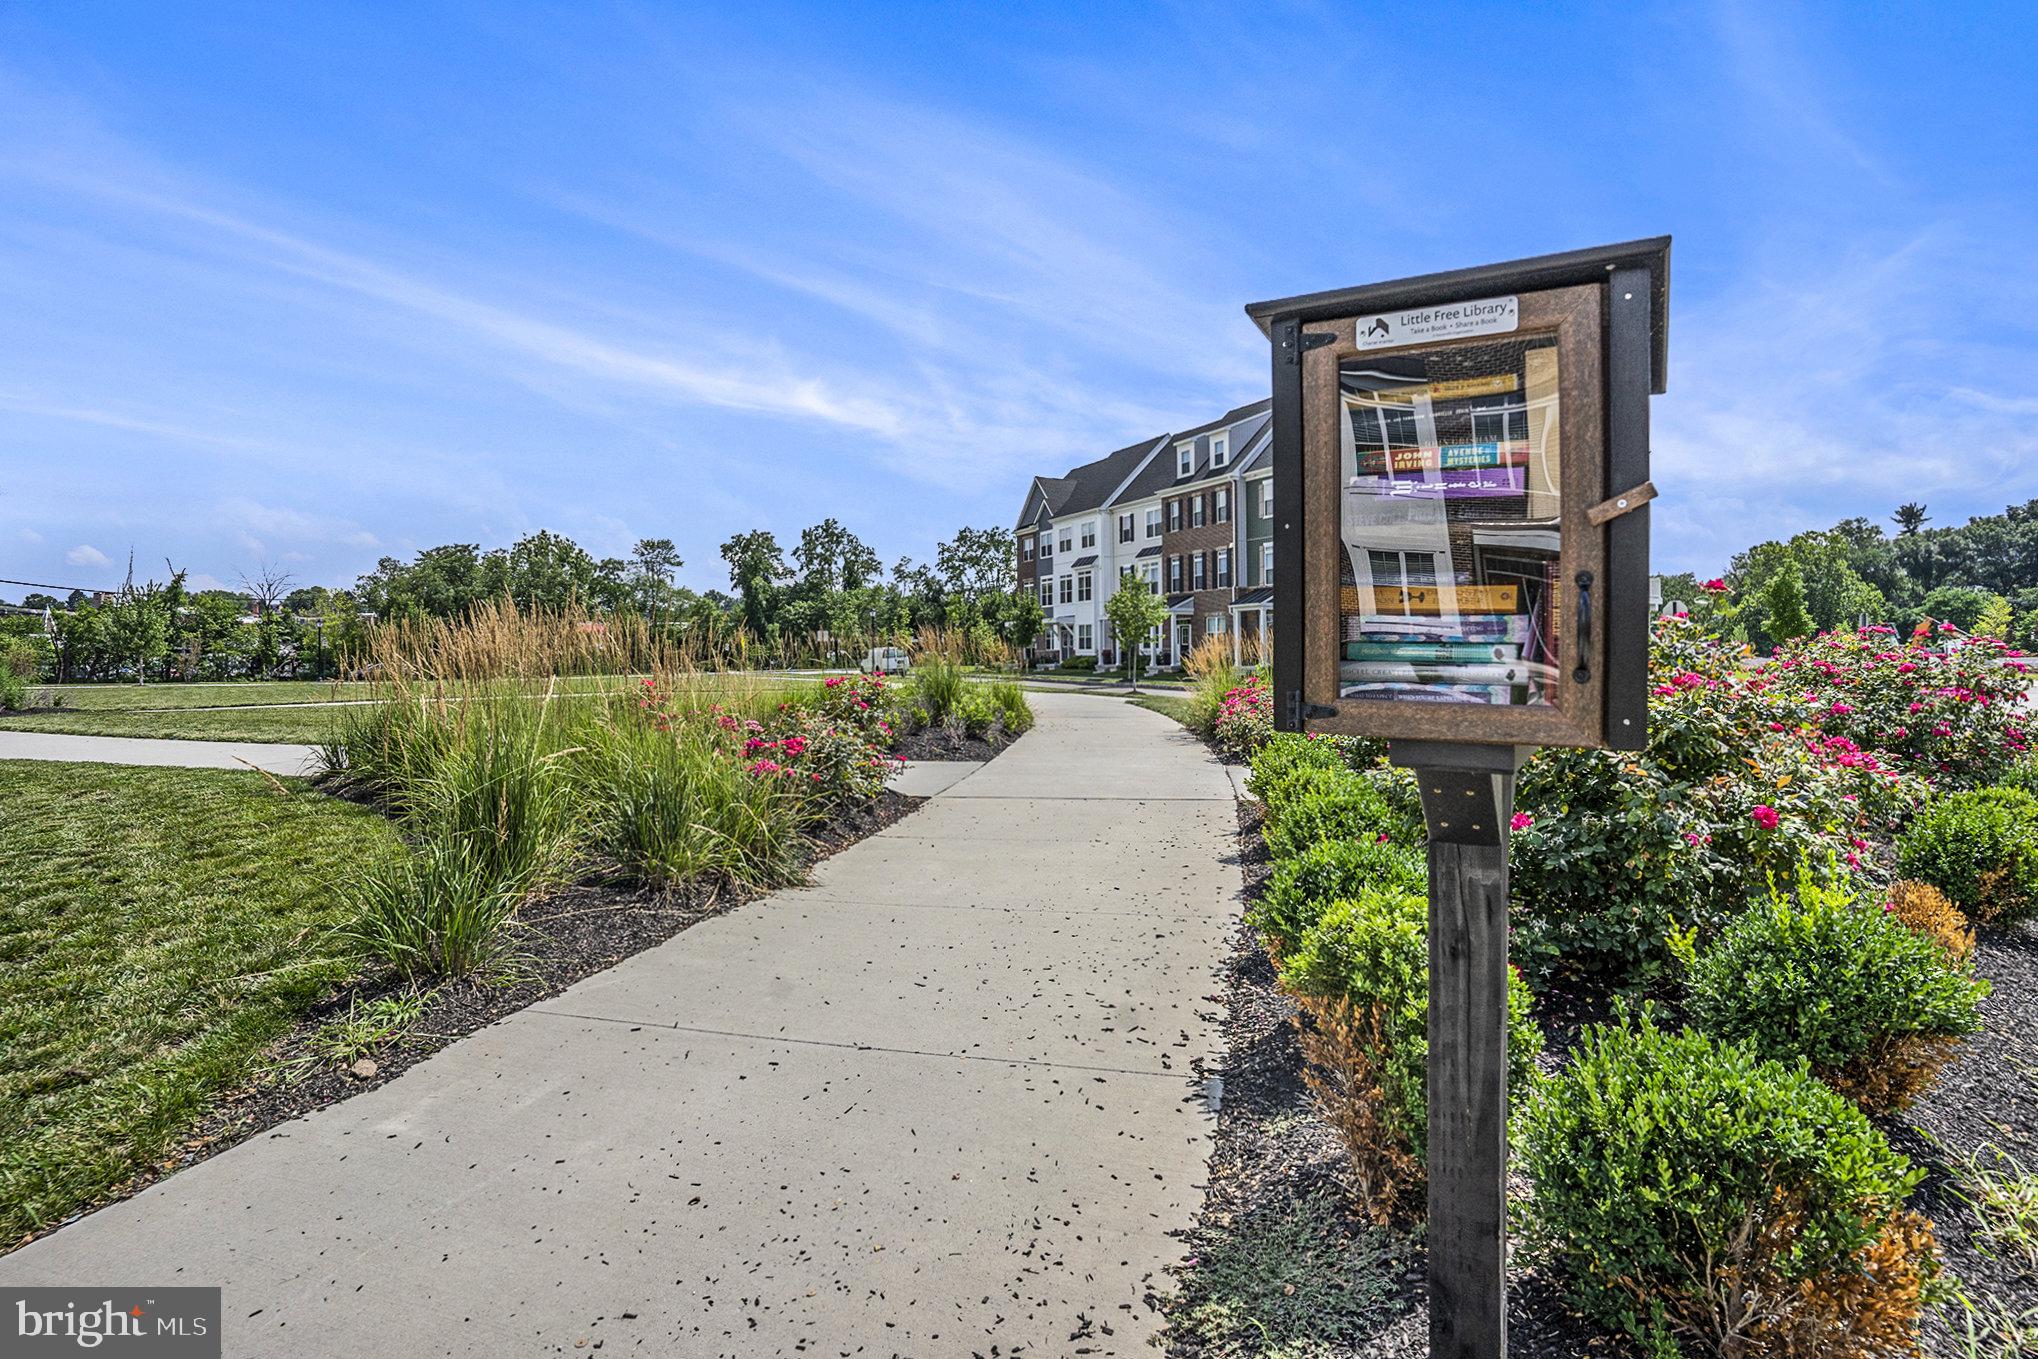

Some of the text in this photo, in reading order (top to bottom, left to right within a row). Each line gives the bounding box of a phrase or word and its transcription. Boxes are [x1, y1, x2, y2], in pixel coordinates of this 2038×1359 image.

[1400, 303, 1507, 327] Little Free Library
[1431, 324, 1447, 332] Book
[1455, 321, 1474, 329] Share
[1481, 318, 1497, 326] Book
[1394, 450, 1433, 461] JOHN
[1447, 447, 1485, 457] AVENUE
[1394, 460, 1433, 469] IRVING
[1447, 455, 1492, 466] MYSTERIES
